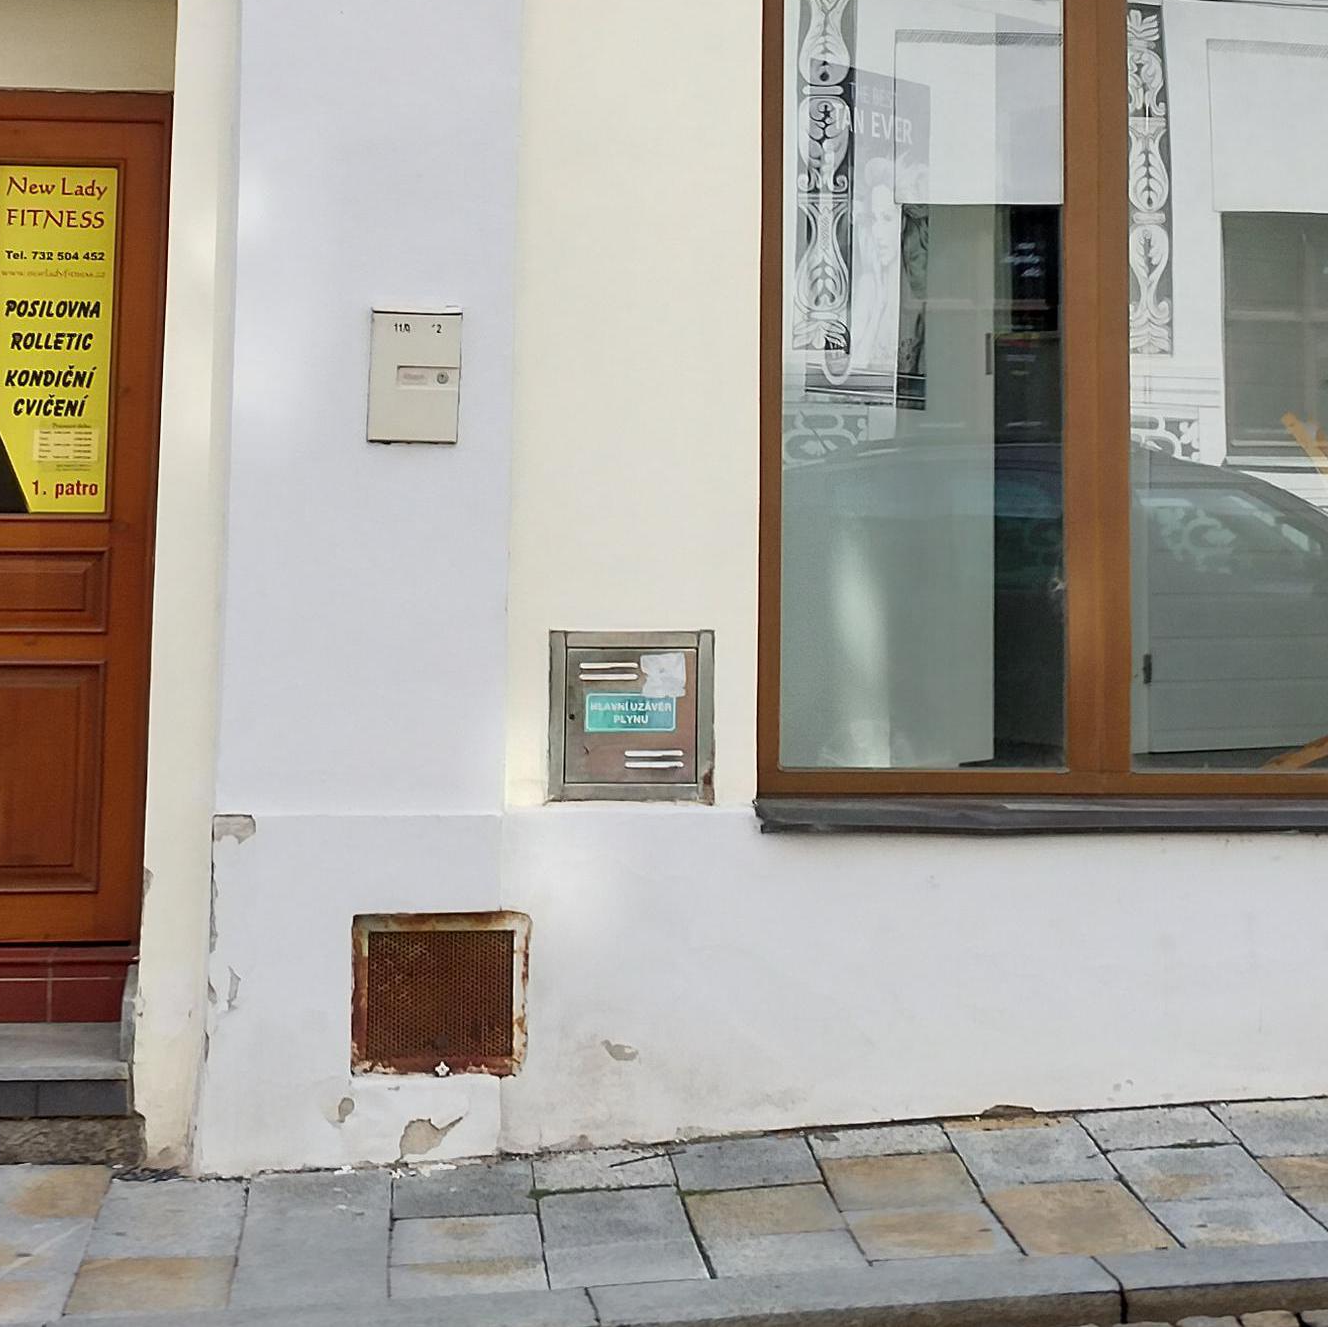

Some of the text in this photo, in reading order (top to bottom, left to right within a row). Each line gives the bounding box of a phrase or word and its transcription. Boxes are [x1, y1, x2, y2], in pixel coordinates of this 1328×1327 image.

[871, 110, 913, 145] EVER
[6, 176, 108, 200] New Lady
[6, 208, 105, 229] FITNESS
[5, 250, 105, 261] Tel. 732 504 452
[5, 299, 101, 318] POSILOVNA
[10, 332, 93, 351] ROLLETIC
[4, 365, 97, 388] KONDIČNÍ
[13, 394, 89, 417] CVIČENÍ
[32, 479, 98, 499] 1. patro
[590, 701, 629, 712] HLAVNÍ
[613, 714, 649, 724] PLYNU
